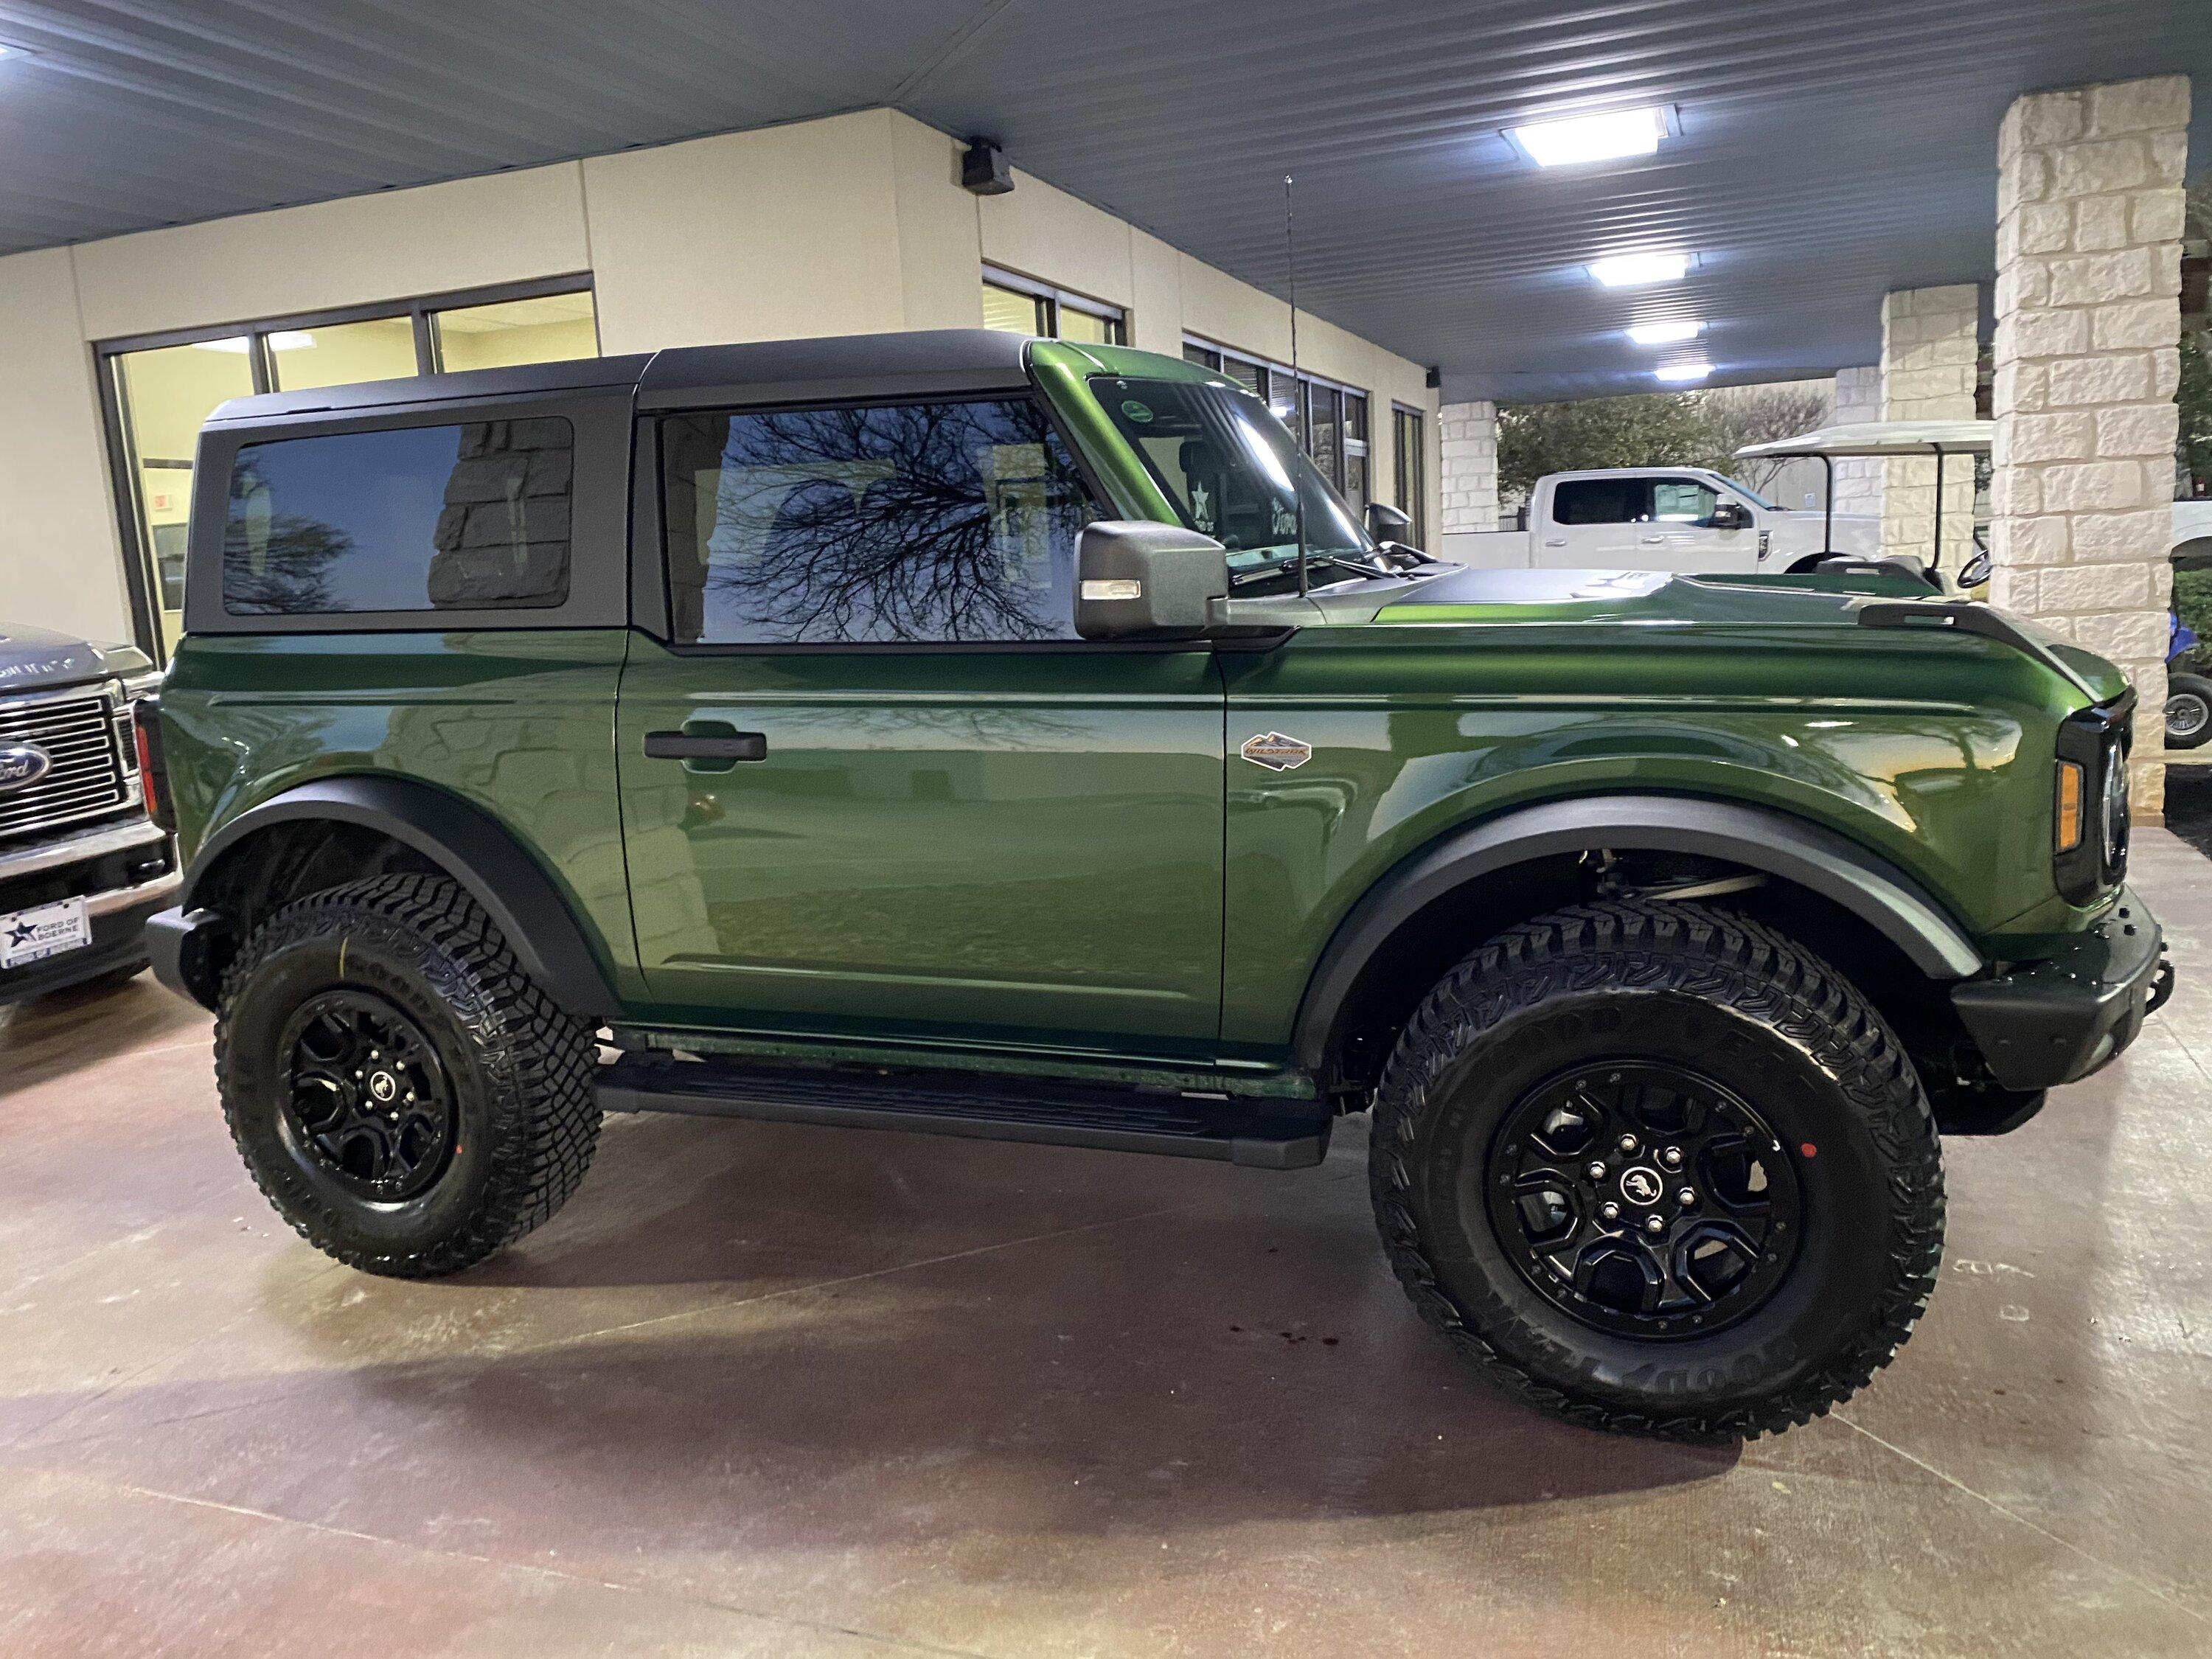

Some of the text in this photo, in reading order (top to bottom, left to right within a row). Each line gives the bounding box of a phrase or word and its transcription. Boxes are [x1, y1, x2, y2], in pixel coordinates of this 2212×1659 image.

[0, 759, 29, 779] ord
[37, 917, 79, 932] FORD OF
[38, 925, 77, 940] BOERNE
